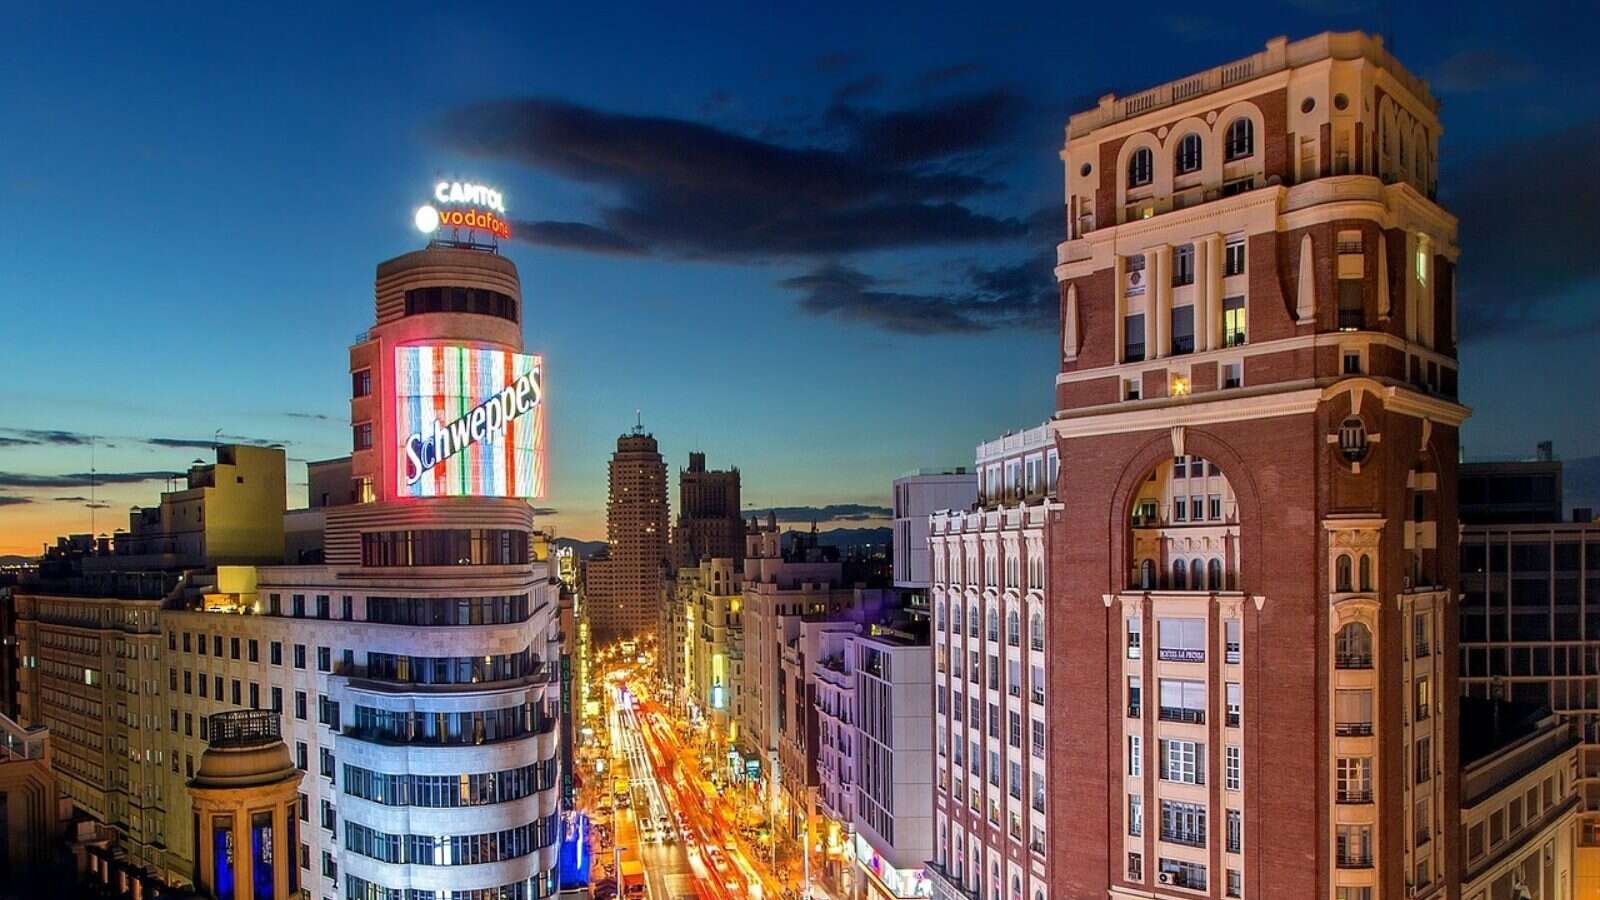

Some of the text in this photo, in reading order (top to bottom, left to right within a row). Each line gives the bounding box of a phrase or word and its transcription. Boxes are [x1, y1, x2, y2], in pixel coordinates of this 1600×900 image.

[435, 182, 505, 213] CAPITOL
[439, 208, 510, 239] vodafone
[406, 366, 541, 486] Schweppes
[564, 774, 572, 808] REX
